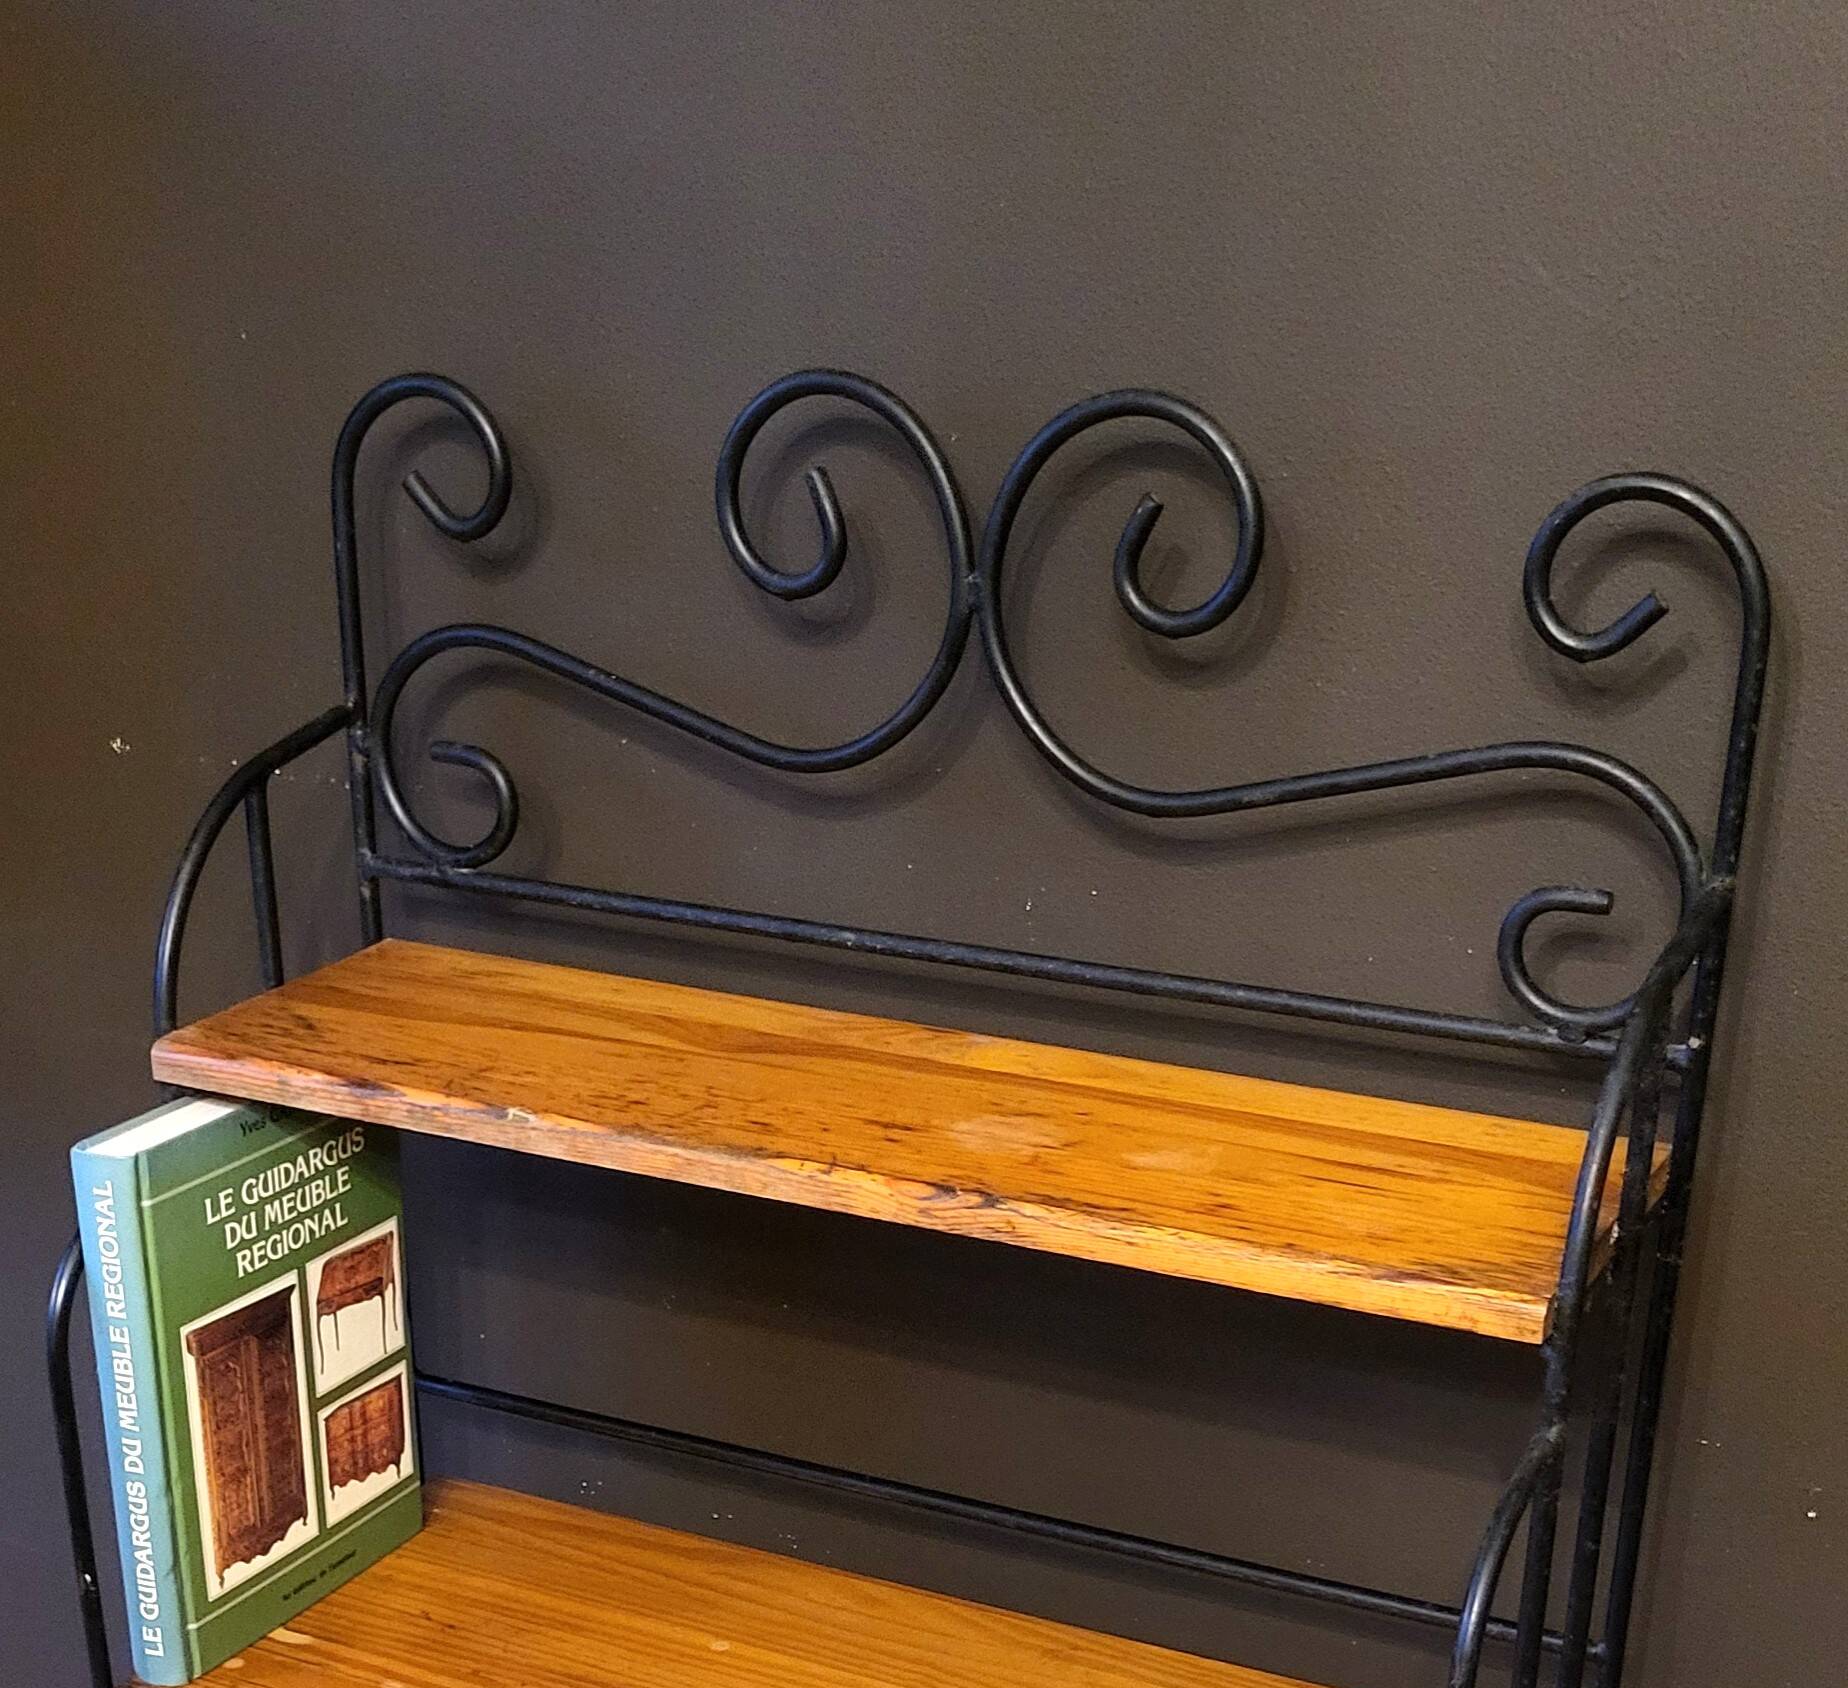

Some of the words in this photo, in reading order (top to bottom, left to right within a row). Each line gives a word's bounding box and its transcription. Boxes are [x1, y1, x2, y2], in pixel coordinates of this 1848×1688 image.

[239, 1119, 268, 1137] Yves
[204, 1188, 236, 1225] LE
[241, 1127, 365, 1205] GUIDARGUS
[224, 1211, 258, 1250] DU
[264, 1166, 351, 1231] MEUBLE
[92, 1180, 128, 1320] REGIONAL
[236, 1202, 348, 1279] REGIONAL
[109, 1325, 141, 1432] MEUBLE
[121, 1438, 145, 1475] DU
[126, 1480, 160, 1621] GUIDARGUS
[142, 1625, 164, 1657] LE
